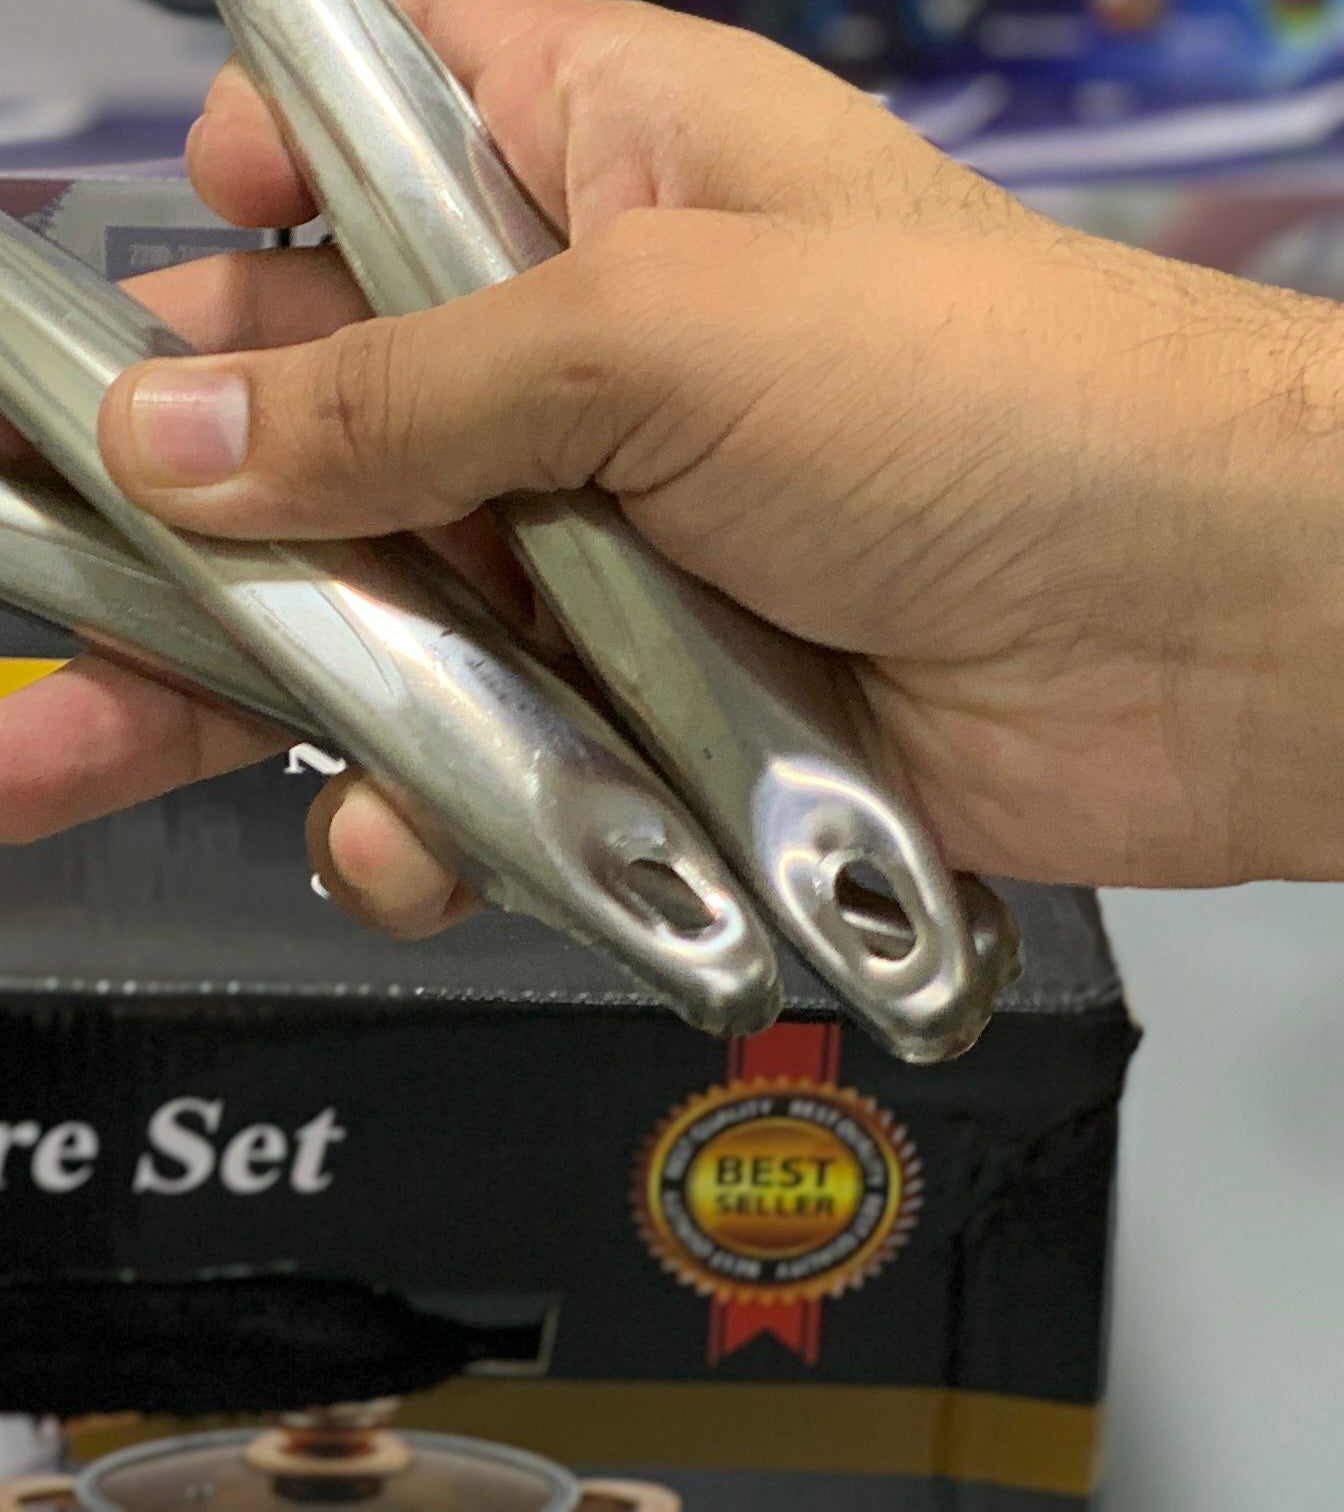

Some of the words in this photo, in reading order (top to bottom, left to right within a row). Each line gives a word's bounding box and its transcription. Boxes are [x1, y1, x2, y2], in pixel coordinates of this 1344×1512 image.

[132, 1096, 346, 1196] Set
[716, 1157, 837, 1188] BEST
[716, 1193, 836, 1217] SELLER
